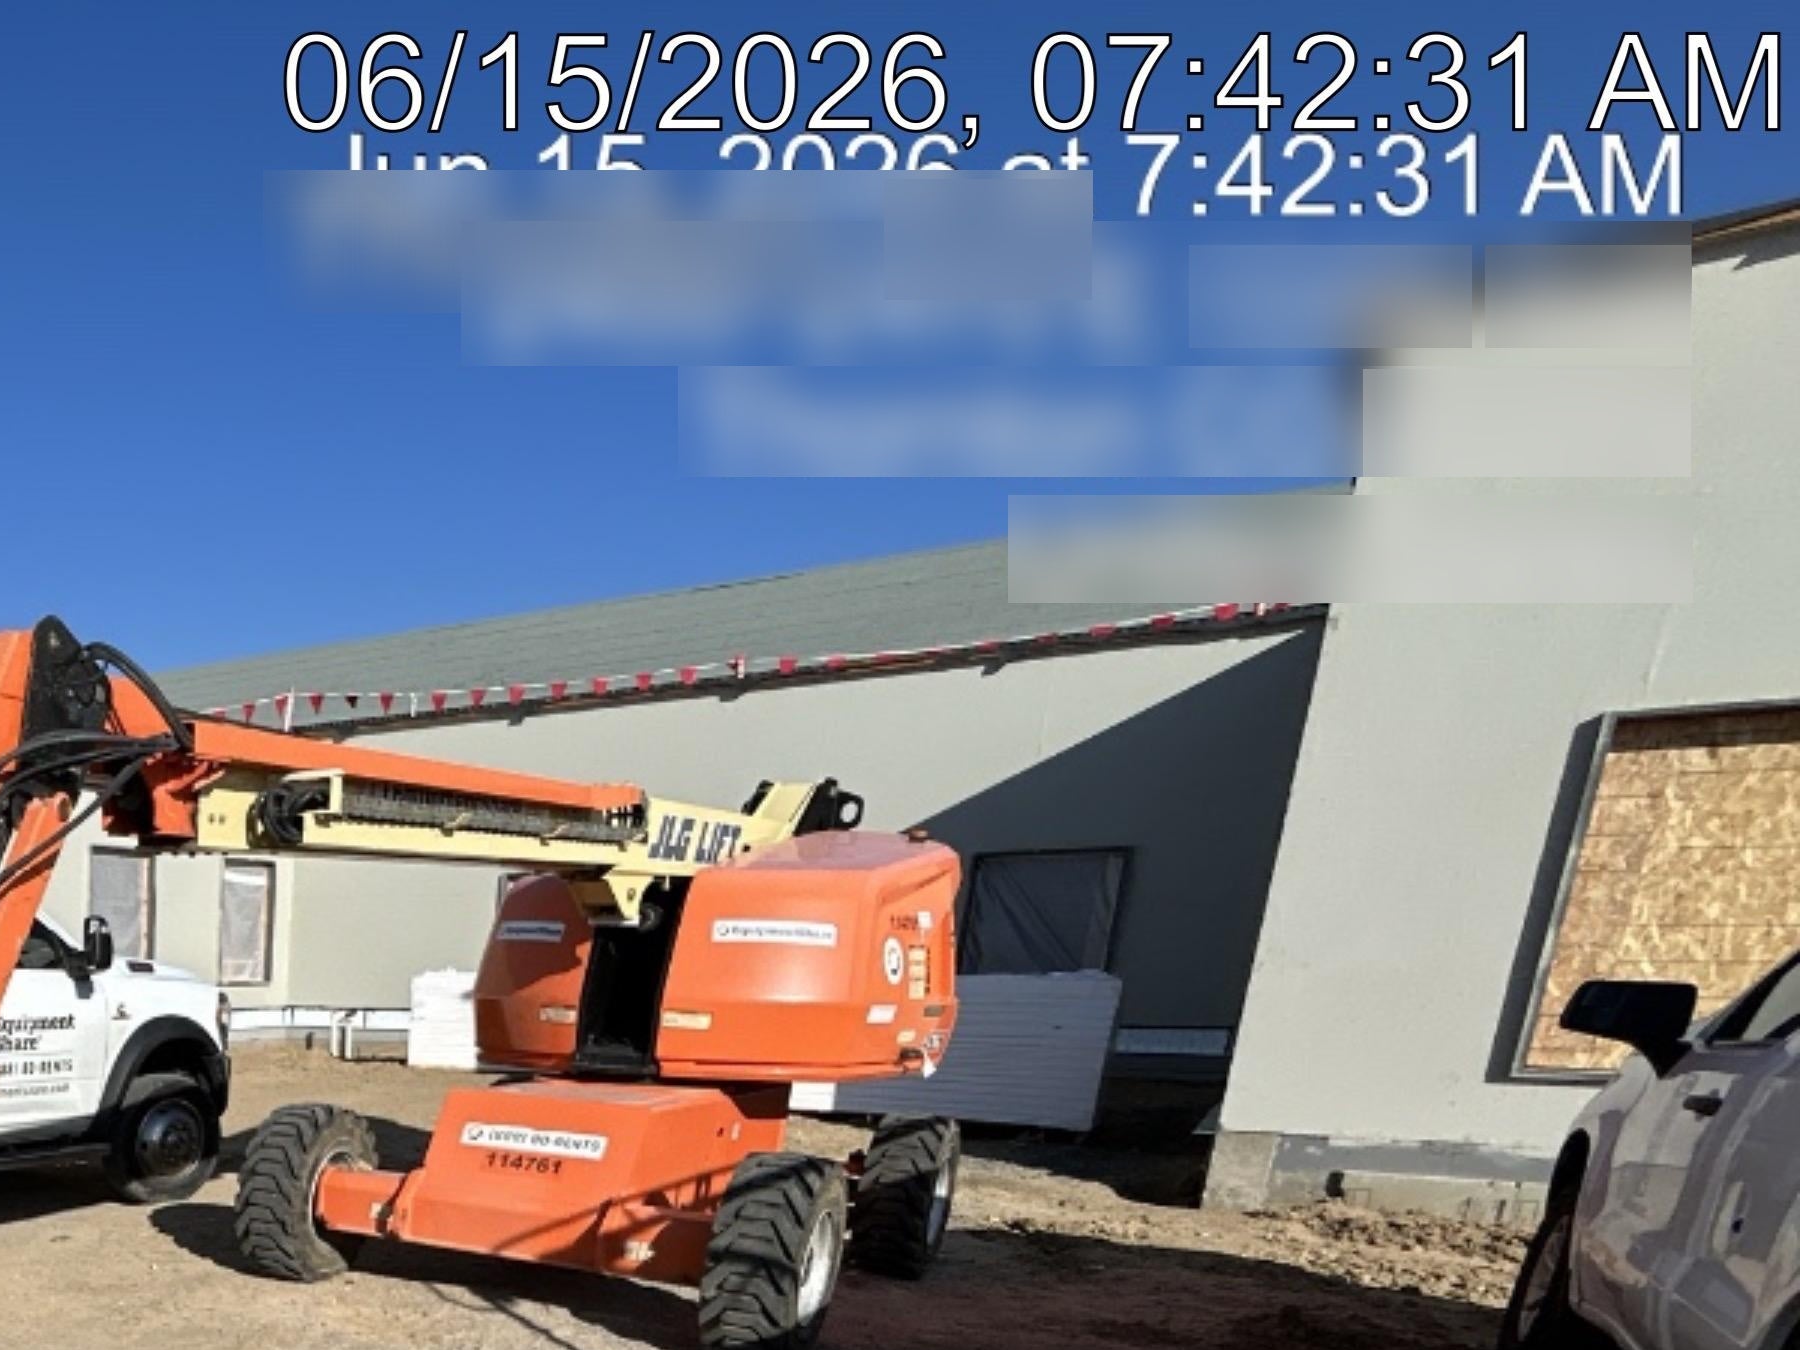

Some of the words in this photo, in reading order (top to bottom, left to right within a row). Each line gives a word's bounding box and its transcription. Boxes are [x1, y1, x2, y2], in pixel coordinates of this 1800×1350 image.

[647, 814, 696, 862] JLG
[693, 820, 742, 866] LIFT
[485, 1151, 563, 1175] 114761
